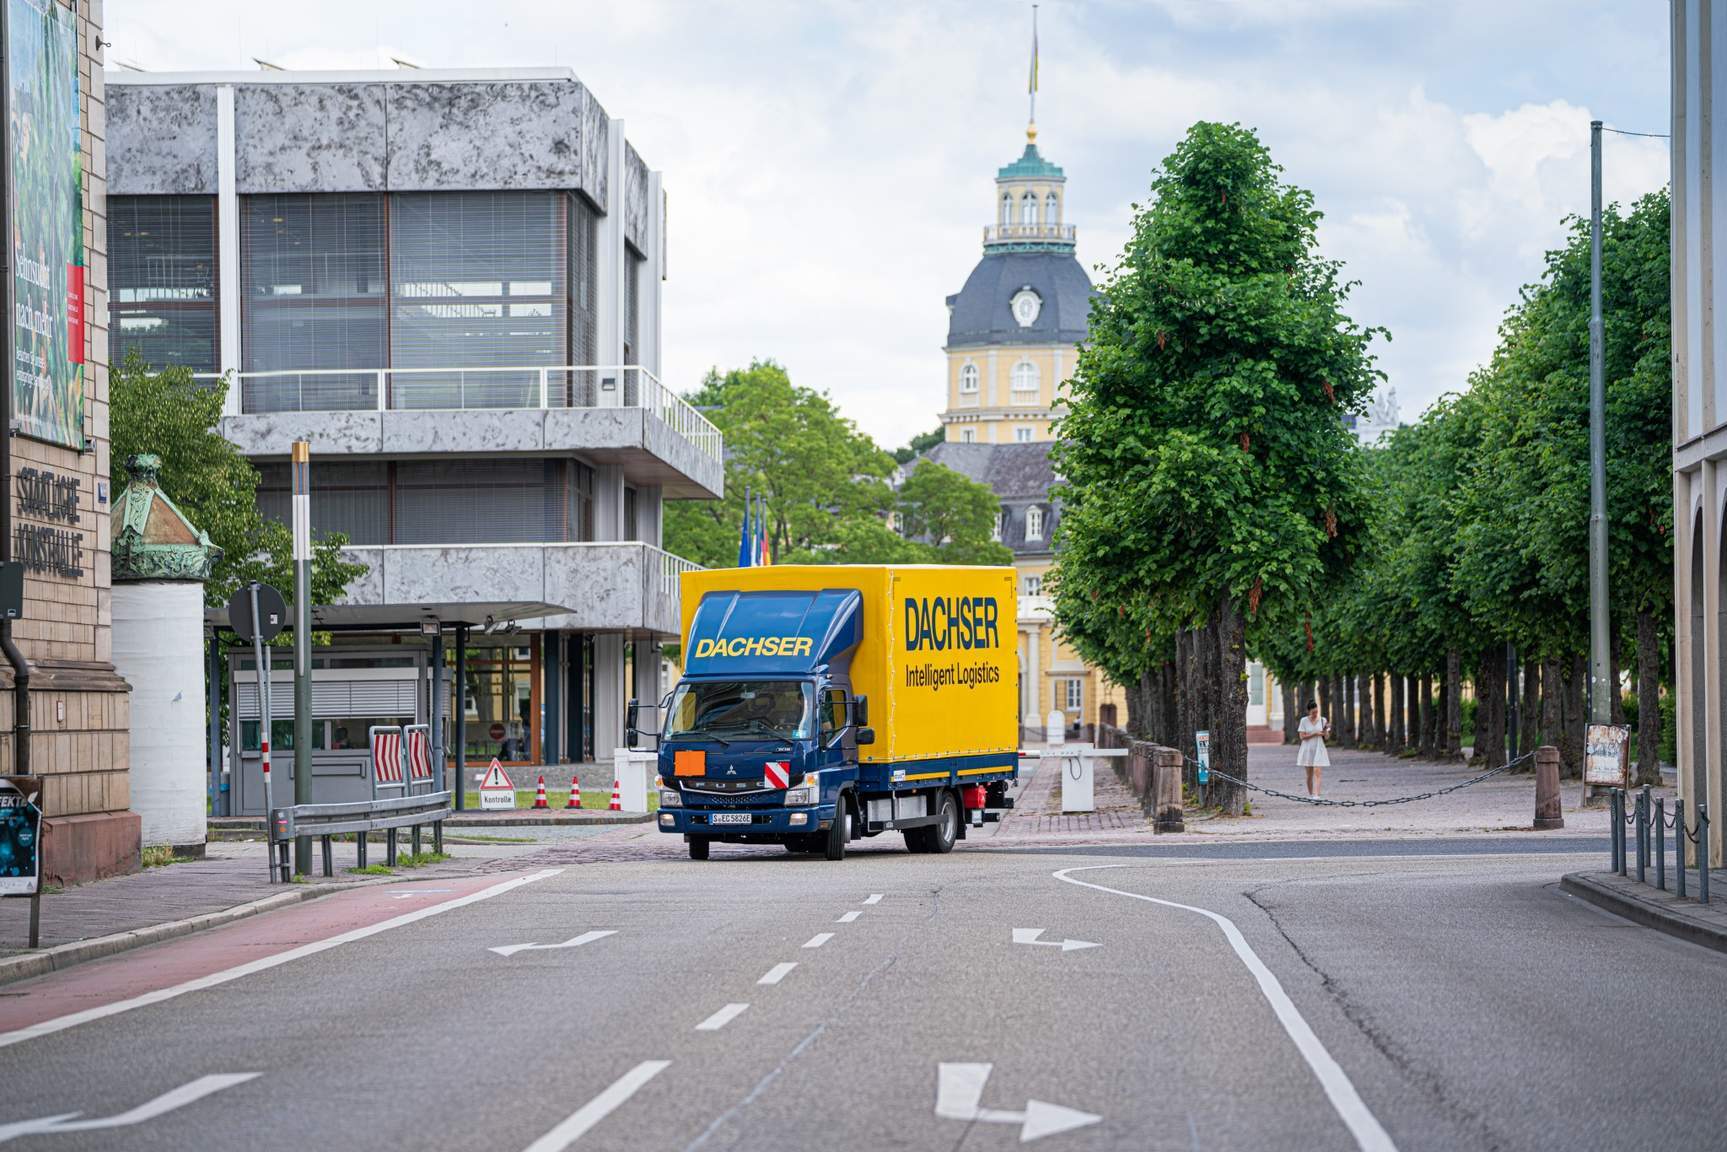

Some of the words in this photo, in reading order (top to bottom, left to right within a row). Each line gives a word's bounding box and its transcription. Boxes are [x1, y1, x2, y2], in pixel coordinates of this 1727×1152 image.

[16, 294, 33, 330] nach
[19, 466, 80, 523] STAATLICHE
[17, 522, 83, 577] KUNSTHALLE
[904, 596, 999, 651] DACHSER
[695, 637, 813, 658] DACHSER
[906, 662, 955, 691] Intelligent
[957, 660, 1000, 690] Logistics
[485, 796, 511, 804] Kontrolle
